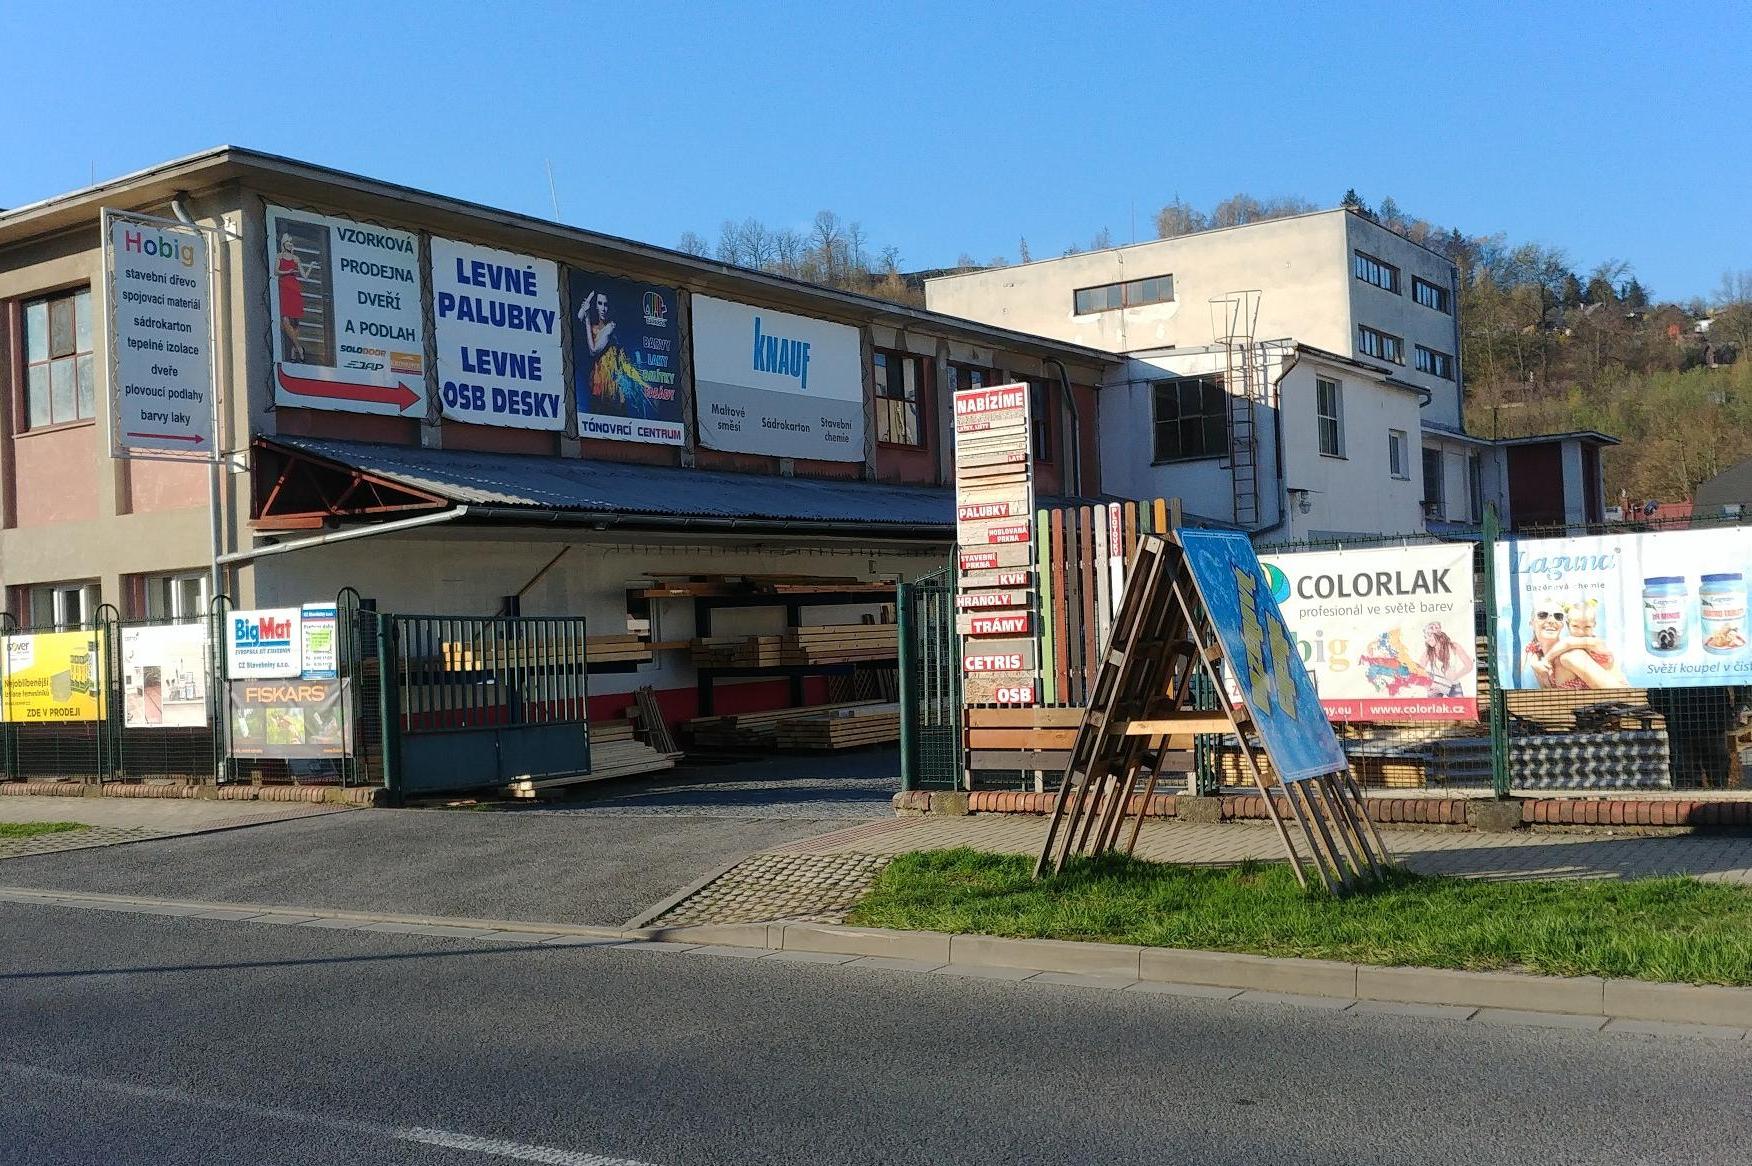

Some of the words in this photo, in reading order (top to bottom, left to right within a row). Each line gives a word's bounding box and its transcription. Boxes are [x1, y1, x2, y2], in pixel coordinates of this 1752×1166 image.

[125, 230, 194, 267] Hobig
[337, 226, 414, 254] VZORKOVÁ
[125, 268, 167, 284] stavební
[169, 274, 197, 288] dřevo
[340, 257, 414, 283] PRODEJNA
[456, 257, 538, 297] LEVNÉ
[122, 290, 165, 305] spojovací
[167, 296, 201, 311] materiál
[357, 290, 401, 310] DVEŘÍ
[438, 291, 555, 335] PALUBKY
[133, 316, 192, 333] sádrokarton
[344, 319, 355, 334] A
[359, 321, 416, 342] PODLAH
[127, 336, 163, 351] tepelné
[166, 341, 199, 355] izolace
[340, 345, 386, 357] SOLODOOR
[753, 317, 811, 389] KNAUF
[151, 364, 178, 377] dveře
[461, 346, 542, 381] LEVNÉ
[125, 384, 165, 398] plovoucí
[168, 388, 203, 403] podlahy
[442, 381, 486, 411] OSB
[492, 387, 560, 418] DESKY
[711, 403, 746, 418] Maltové
[956, 392, 1024, 414] NABÍZÍME
[141, 409, 168, 424] barvy
[171, 412, 191, 426] laky
[717, 420, 741, 432] směsi
[761, 417, 810, 433] Sádrokarton
[821, 417, 852, 430] Stavební
[581, 418, 633, 436] TÓNOVACÍ
[637, 426, 681, 441] CENTRUM
[824, 431, 849, 443] chemie
[959, 503, 1007, 519] PALUBKY
[997, 535, 1020, 543] PRKNA
[960, 553, 997, 562] STAVEBNÍ
[965, 561, 991, 569] PRKNA
[1000, 573, 1026, 585] KVH
[1297, 568, 1453, 600] COLORLAK
[956, 594, 1010, 607] HRANOLY
[1299, 603, 1363, 619] profesionál
[1367, 605, 1381, 615] ve
[1385, 602, 1416, 614] světě
[1420, 602, 1454, 614] barev
[234, 616, 291, 647] BigMat
[972, 617, 1025, 633] TRÁMY
[964, 654, 1021, 671] CETRIS
[1647, 663, 1677, 674] Svěží
[1679, 661, 1720, 674] koupel
[1723, 664, 1731, 672] v
[245, 685, 325, 703] FISKARS
[997, 688, 1032, 703] OSB
[26, 708, 41, 717] ZDE
[42, 708, 48, 717] V
[49, 707, 81, 717] PRODEJI
[1370, 702, 1465, 716] www.colorlak.cz
